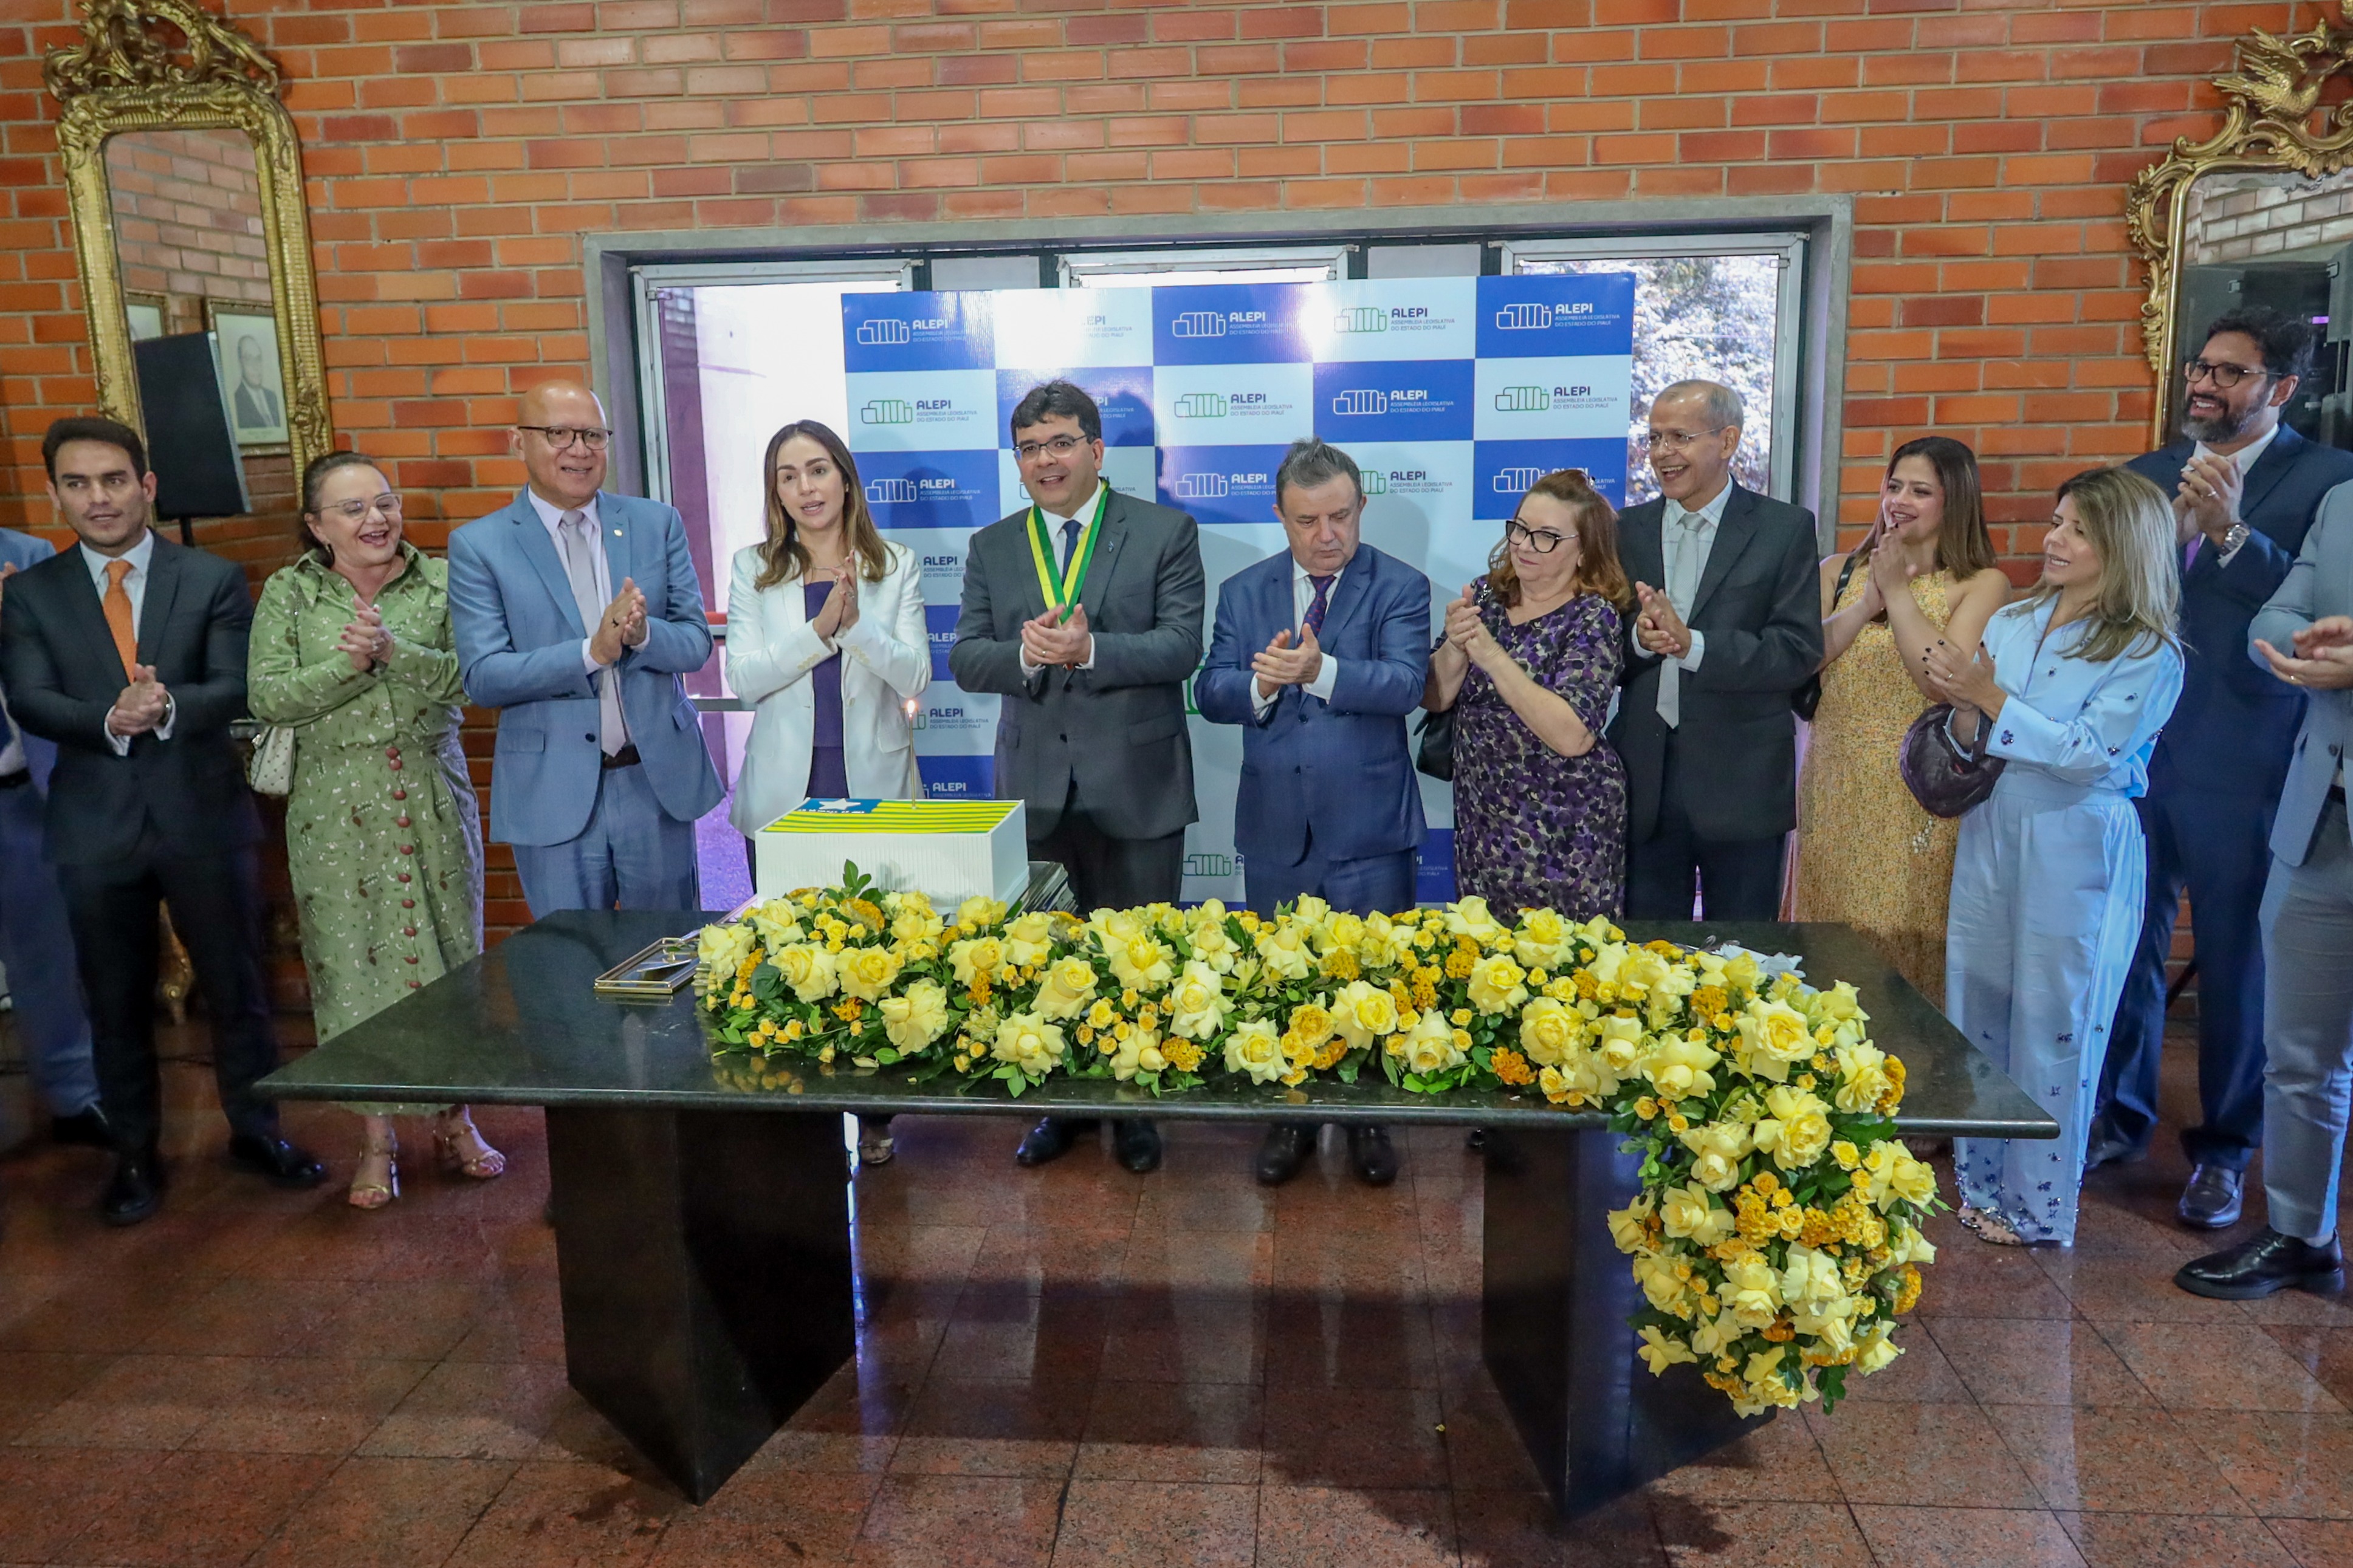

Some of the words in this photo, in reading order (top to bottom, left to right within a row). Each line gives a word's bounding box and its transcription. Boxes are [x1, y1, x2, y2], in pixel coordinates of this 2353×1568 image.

[1391, 307, 1427, 318] ALEPI
[1555, 303, 1593, 315] ALEPI
[1229, 311, 1266, 323] ALEPI
[913, 319, 948, 330] ALEPI
[1390, 389, 1427, 401] ALEPI
[1553, 386, 1591, 397] ALEPI
[1231, 393, 1266, 404] ALEPI
[916, 400, 951, 410] ALEPI
[1231, 473, 1266, 484] ALEPI
[1390, 470, 1426, 481] ALEPI
[919, 478, 955, 490] ALEPI
[923, 555, 957, 566] ALEPI
[928, 632, 957, 643] ALEP
[929, 708, 963, 718] ALEPI
[932, 782, 967, 792] ALEPI
